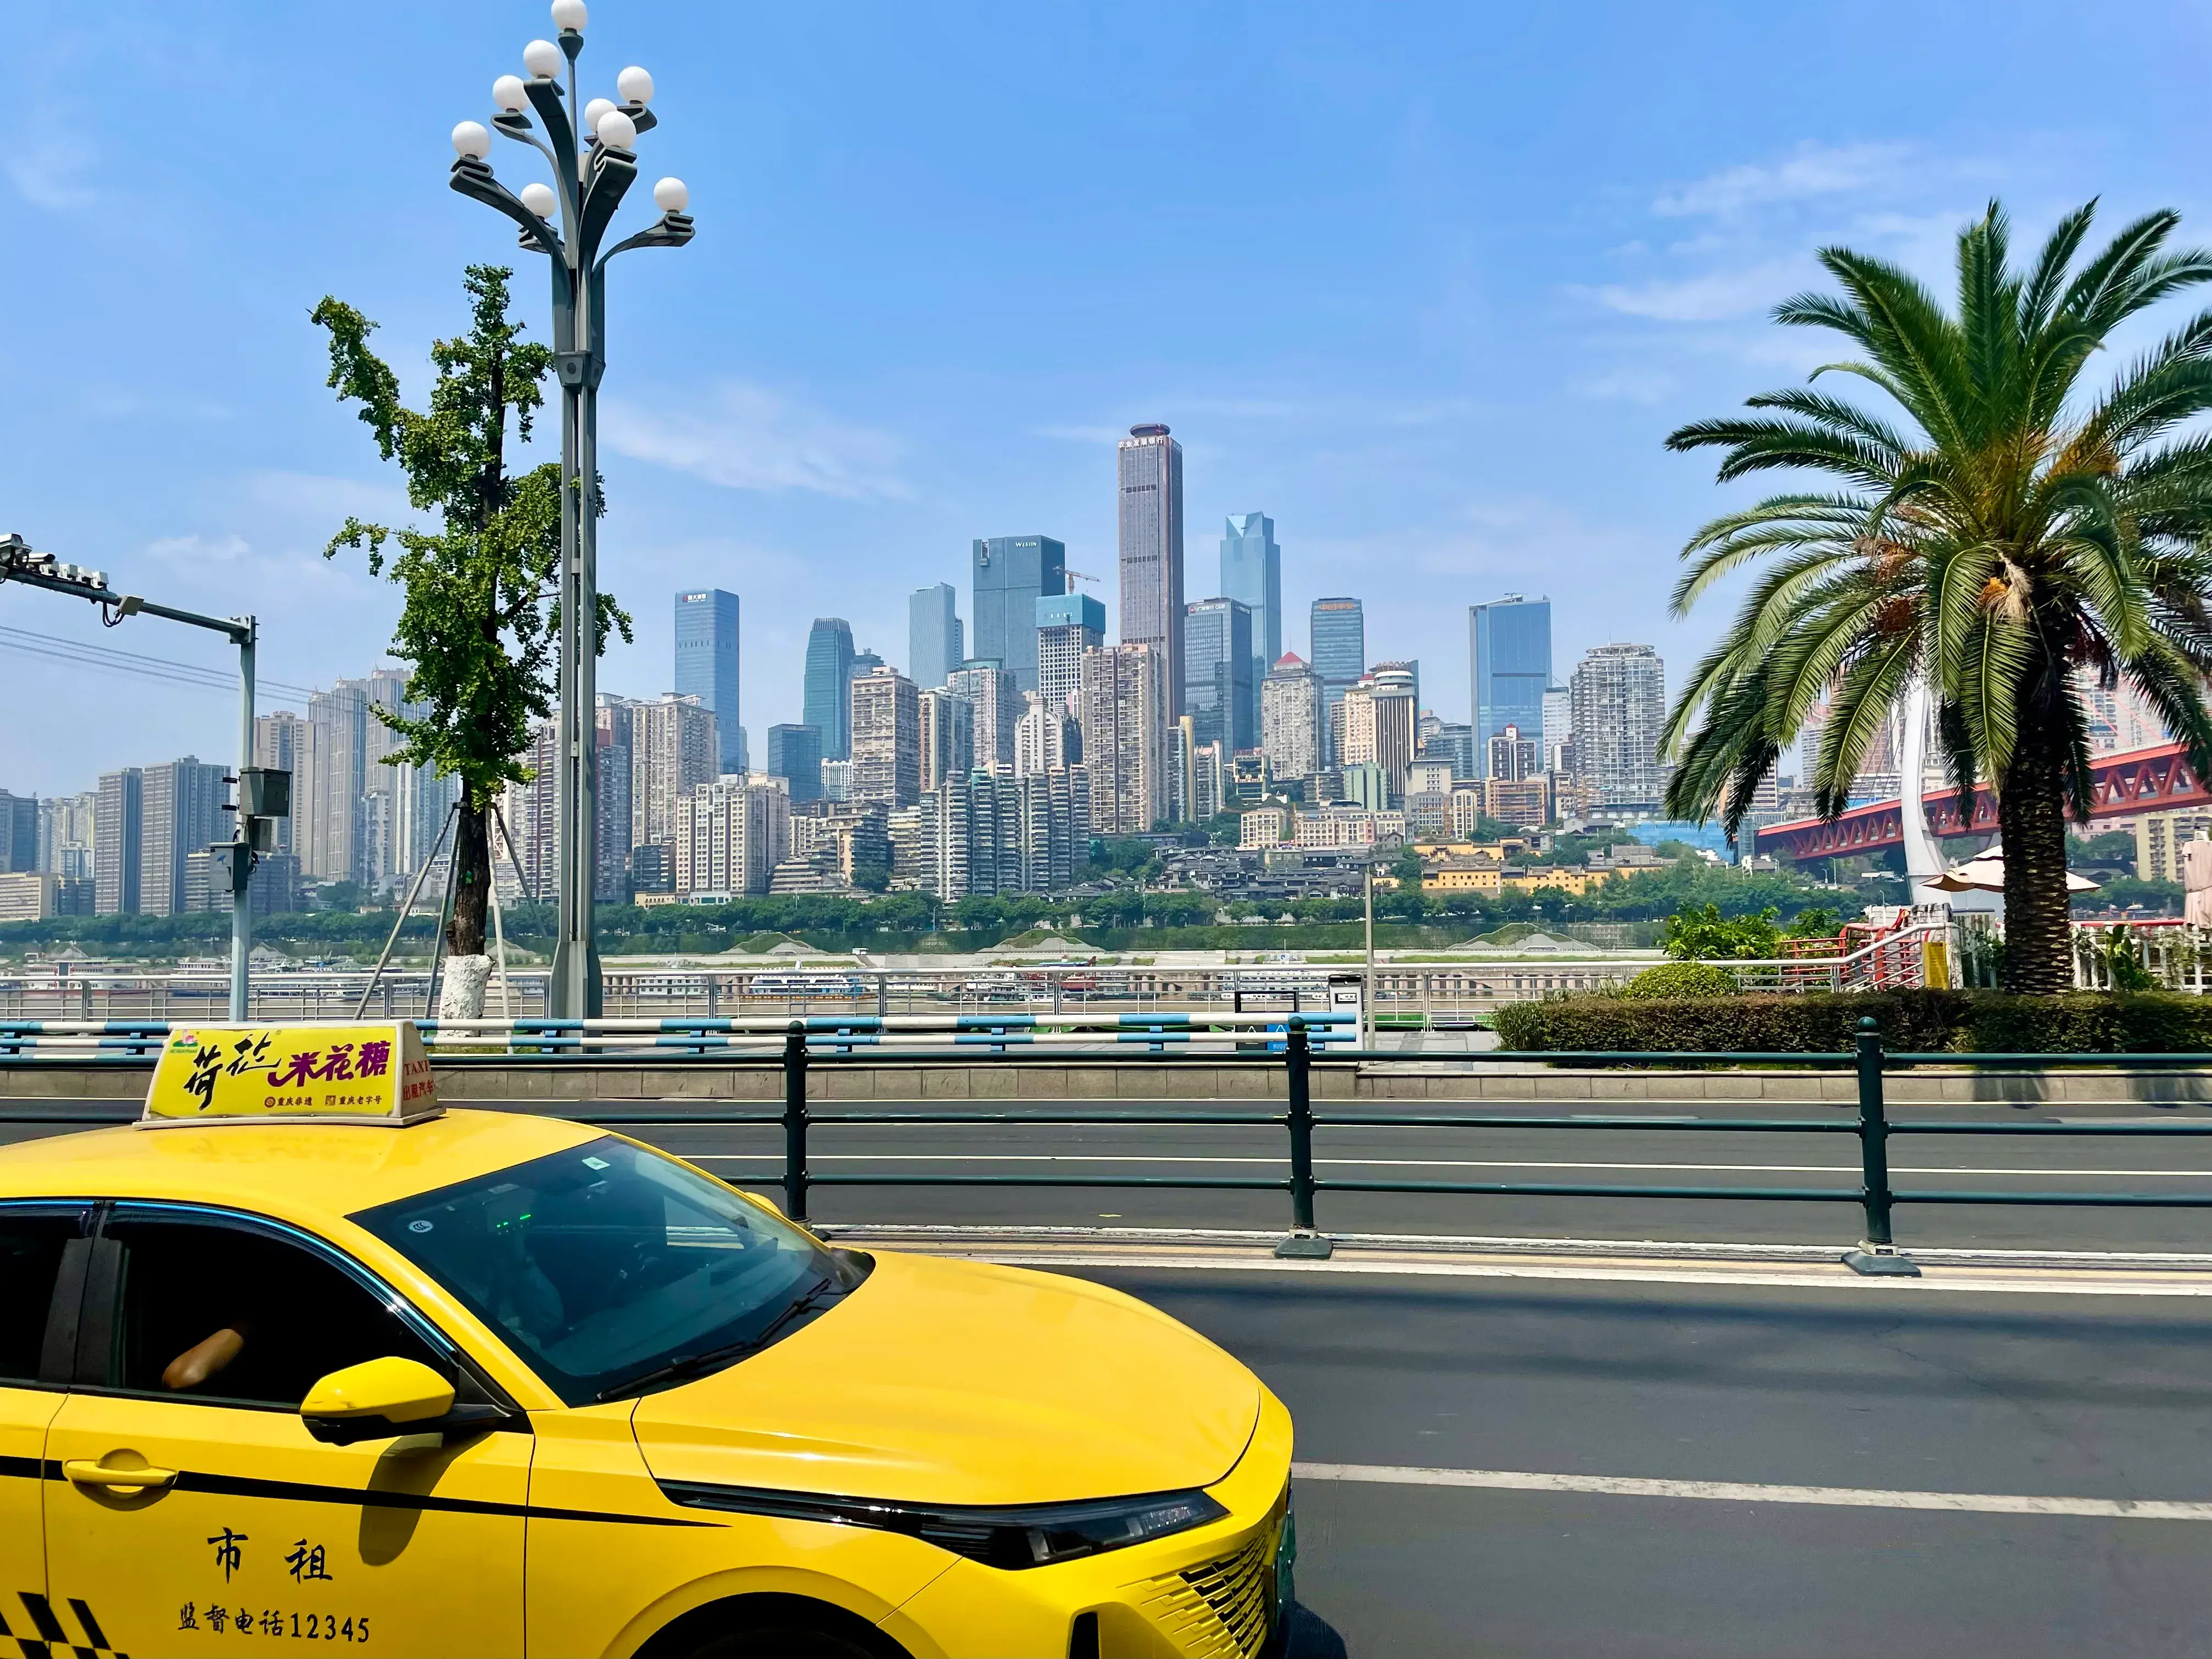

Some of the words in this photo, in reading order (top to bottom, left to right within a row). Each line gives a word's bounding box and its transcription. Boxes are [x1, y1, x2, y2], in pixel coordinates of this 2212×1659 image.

[267, 1040, 391, 1087] 米花糖
[404, 1060, 428, 1075] TAXI
[404, 1079, 434, 1101] 出租汽车
[339, 1095, 382, 1105] 重庆老字号
